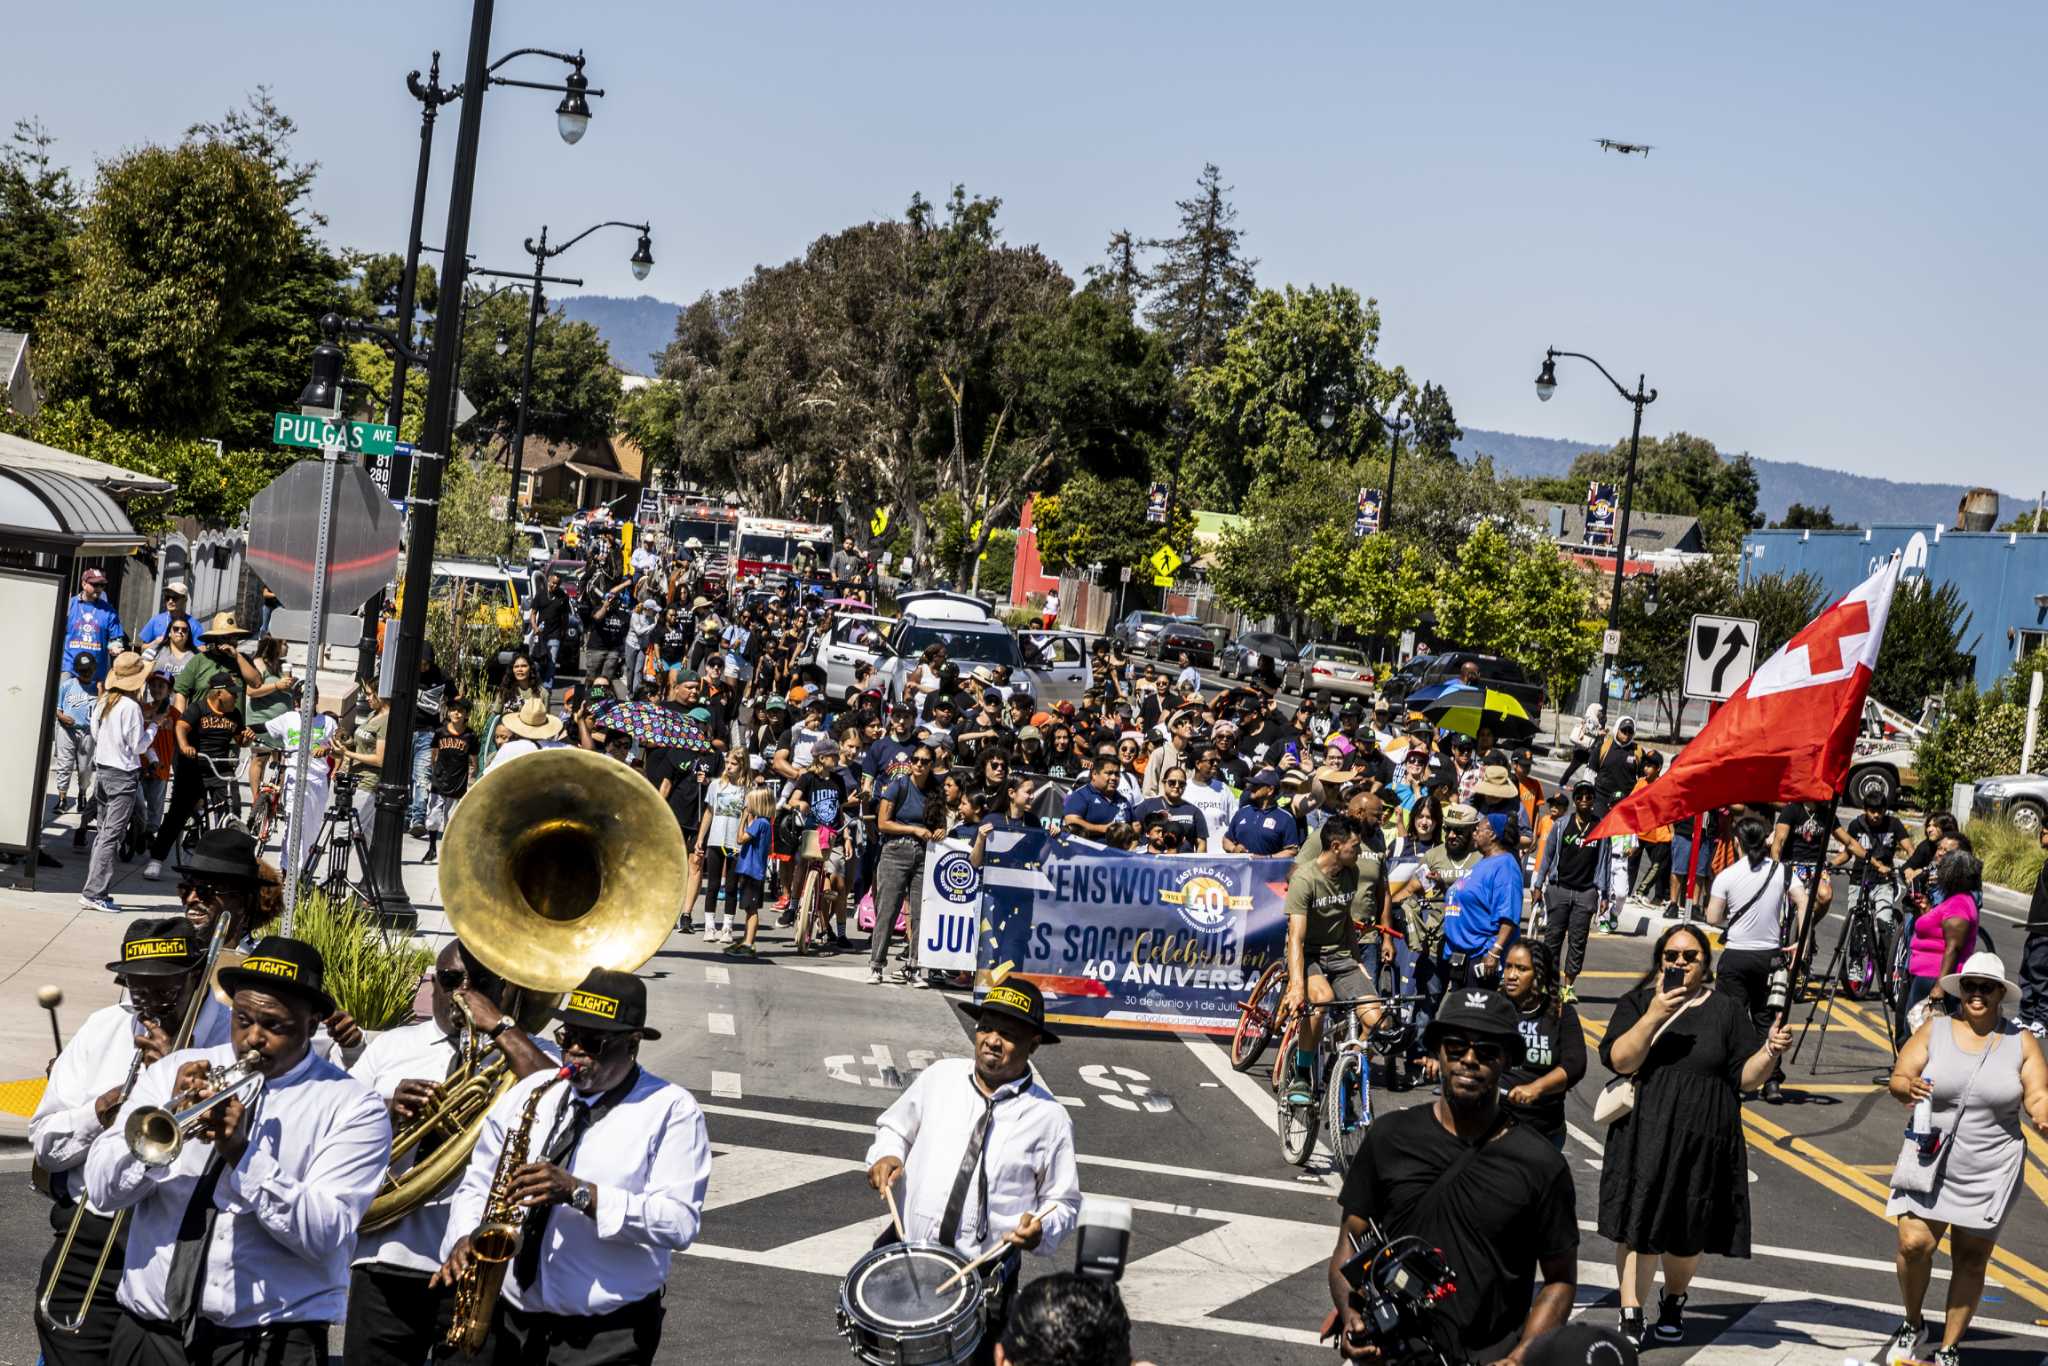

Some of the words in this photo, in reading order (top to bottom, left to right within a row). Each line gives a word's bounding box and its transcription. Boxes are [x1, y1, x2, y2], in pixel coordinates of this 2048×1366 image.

[279, 417, 364, 448] PULGAS
[373, 430, 393, 442] AVE
[376, 454, 390, 467] 81
[370, 467, 389, 483] 280
[1175, 868, 1192, 885] EAST
[1193, 867, 1214, 876] PALO
[1215, 871, 1234, 887] ALTO
[1191, 886, 1224, 914] 40
[131, 940, 179, 956] TWILIGHT
[1082, 959, 1116, 981] 40
[1124, 996, 1137, 1005] 30
[1139, 996, 1153, 1007] de
[1155, 998, 1184, 1009] Junio
[1200, 1000, 1215, 1010] de
